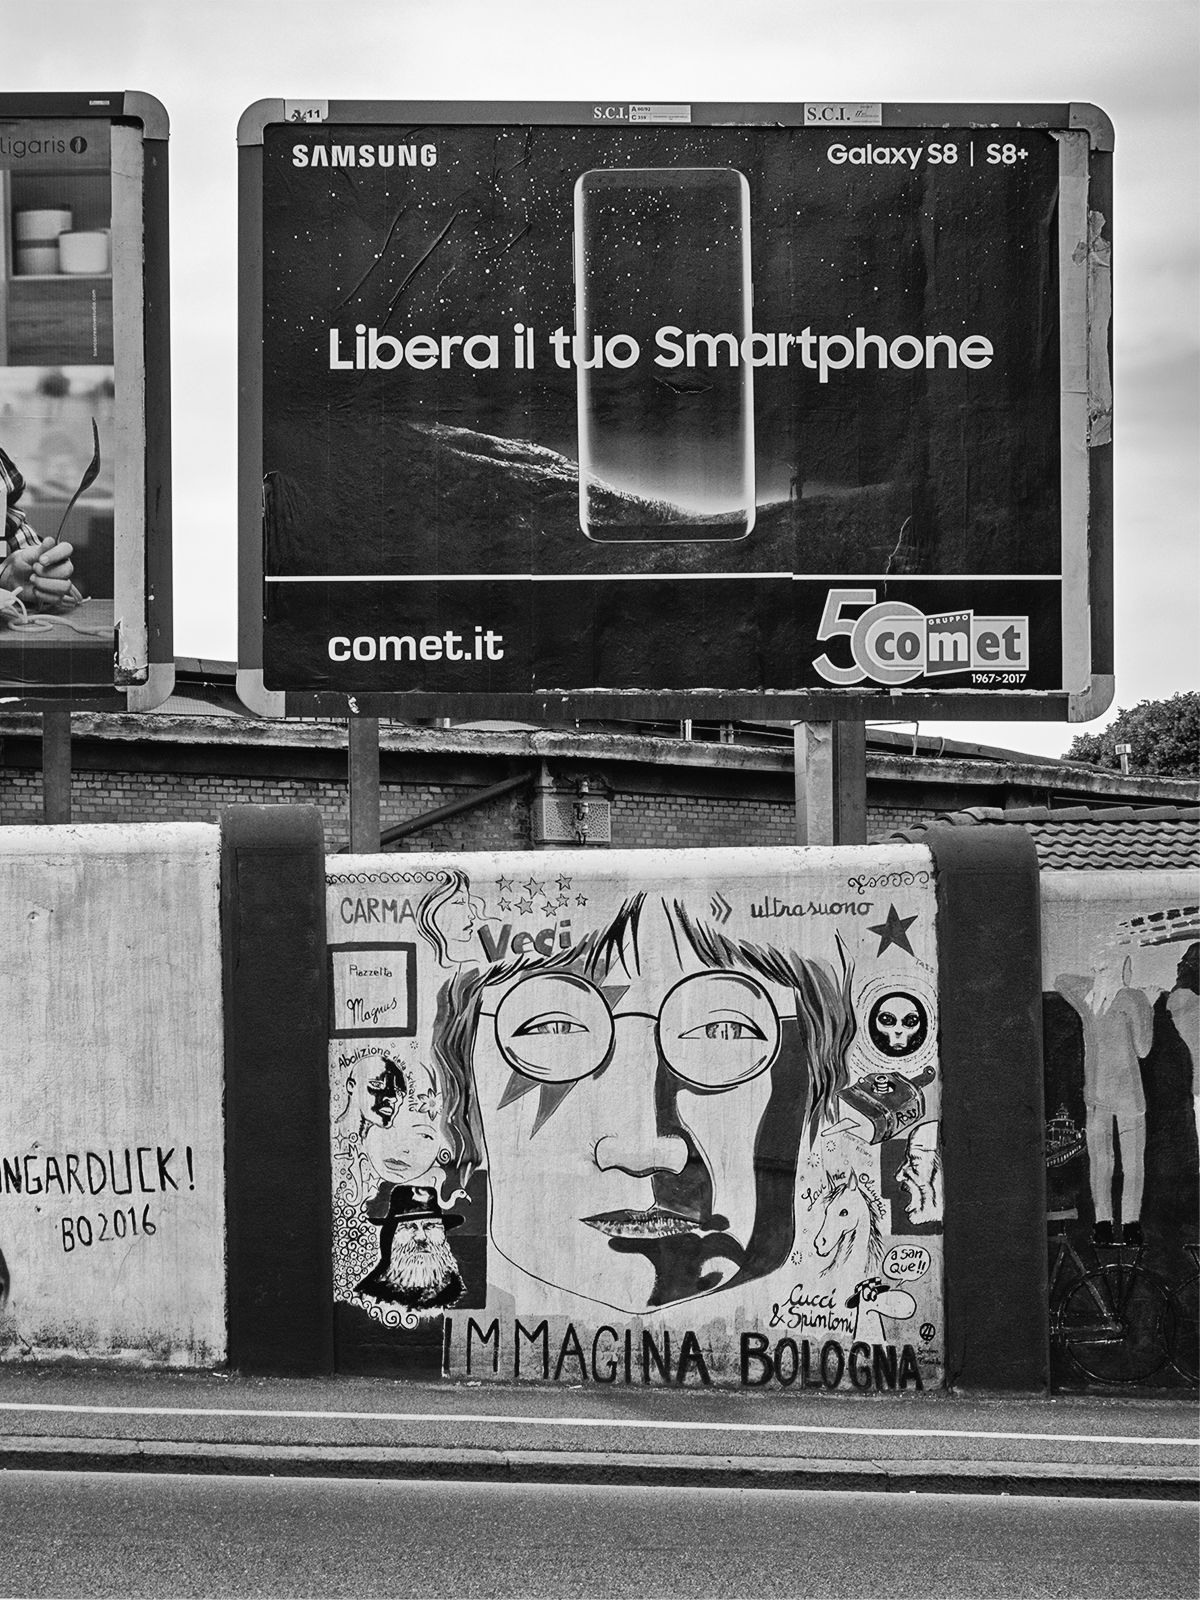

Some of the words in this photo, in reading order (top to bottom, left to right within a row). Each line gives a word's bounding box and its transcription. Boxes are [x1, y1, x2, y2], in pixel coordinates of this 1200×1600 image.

[292, 144, 437, 168] SAMSUNG
[827, 143, 923, 170] Galaxy
[927, 143, 958, 165] S8
[986, 143, 1028, 164] S8+
[330, 323, 499, 370] Libera
[514, 322, 535, 370] il
[549, 327, 640, 369] tuo
[653, 325, 994, 384] Smartphone
[928, 614, 969, 625] GRUPPO
[328, 625, 505, 662] comet.it
[874, 625, 1021, 662] comet
[340, 897, 418, 925] CARMA
[750, 895, 874, 919] ultrasuono
[346, 997, 398, 1026] Magnus
[739, 1332, 925, 1391] BOLOGNA
